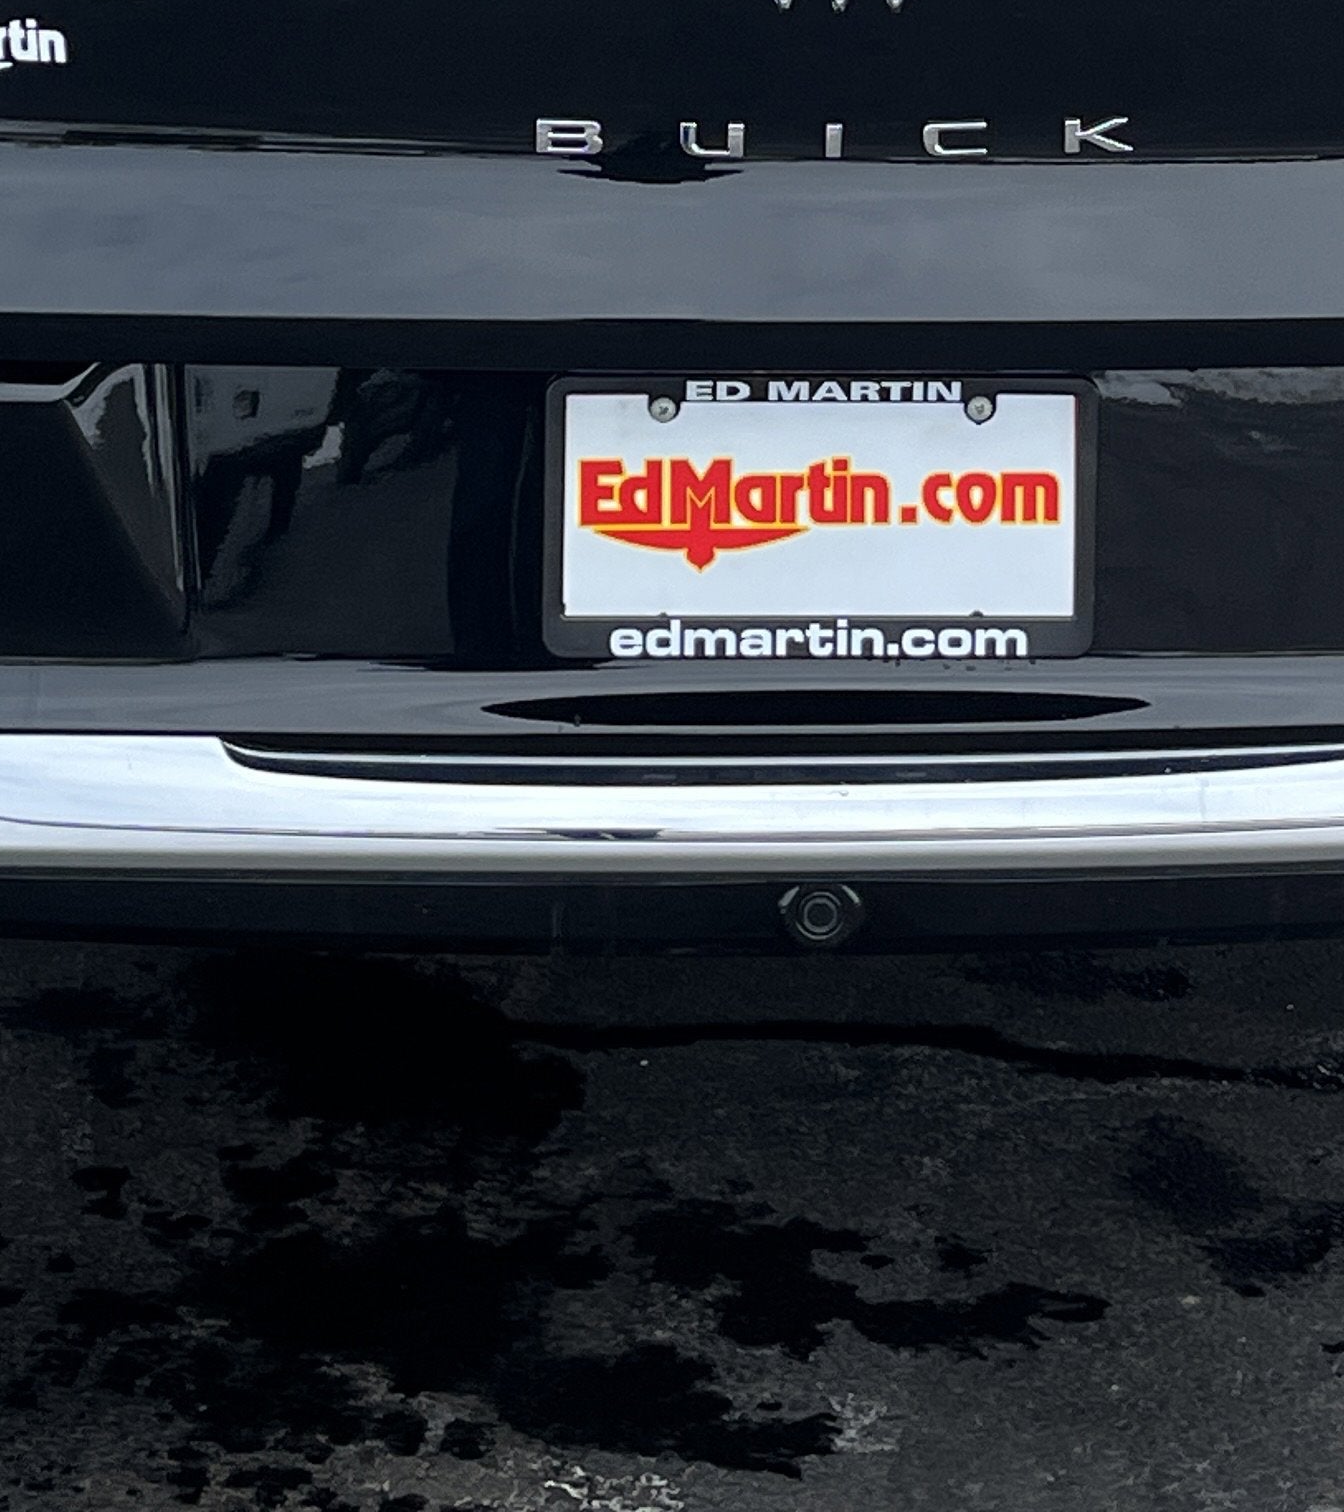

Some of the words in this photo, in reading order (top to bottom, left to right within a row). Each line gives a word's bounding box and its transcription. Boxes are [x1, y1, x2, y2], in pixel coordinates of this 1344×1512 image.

[536, 117, 1134, 159] BUICK
[684, 379, 751, 402] ED
[767, 380, 963, 402] MARTIN
[577, 456, 1062, 528] EdMartin.com
[608, 618, 1029, 658] edmartin.com
